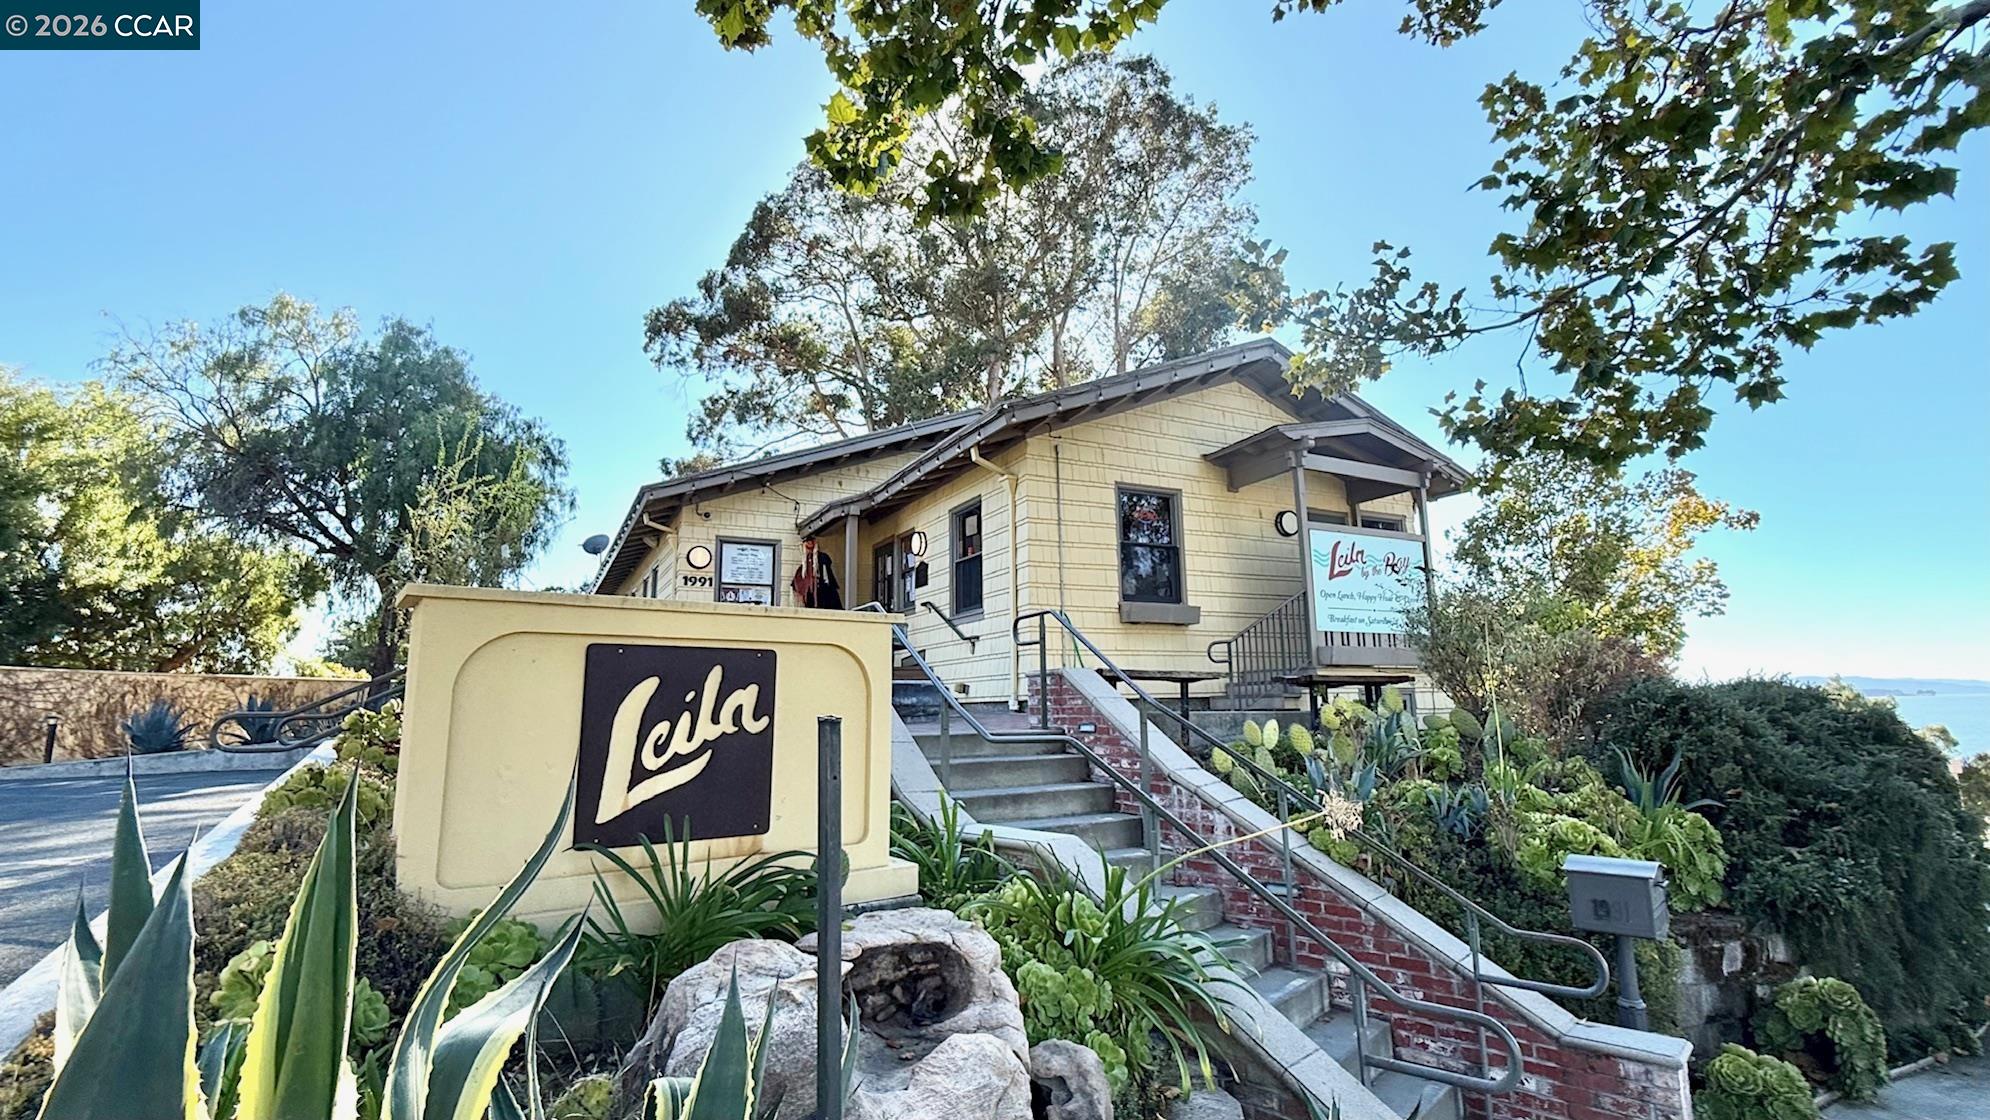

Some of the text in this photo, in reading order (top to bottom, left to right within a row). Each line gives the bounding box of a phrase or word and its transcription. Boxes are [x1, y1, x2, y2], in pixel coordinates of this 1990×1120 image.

[1329, 540, 1367, 580] Leila
[682, 575, 713, 587] 1991
[1320, 589, 1337, 601] Open
[1356, 591, 1377, 605] Happy
[1328, 614, 1358, 627] Breakfast
[594, 664, 770, 825] Leila
